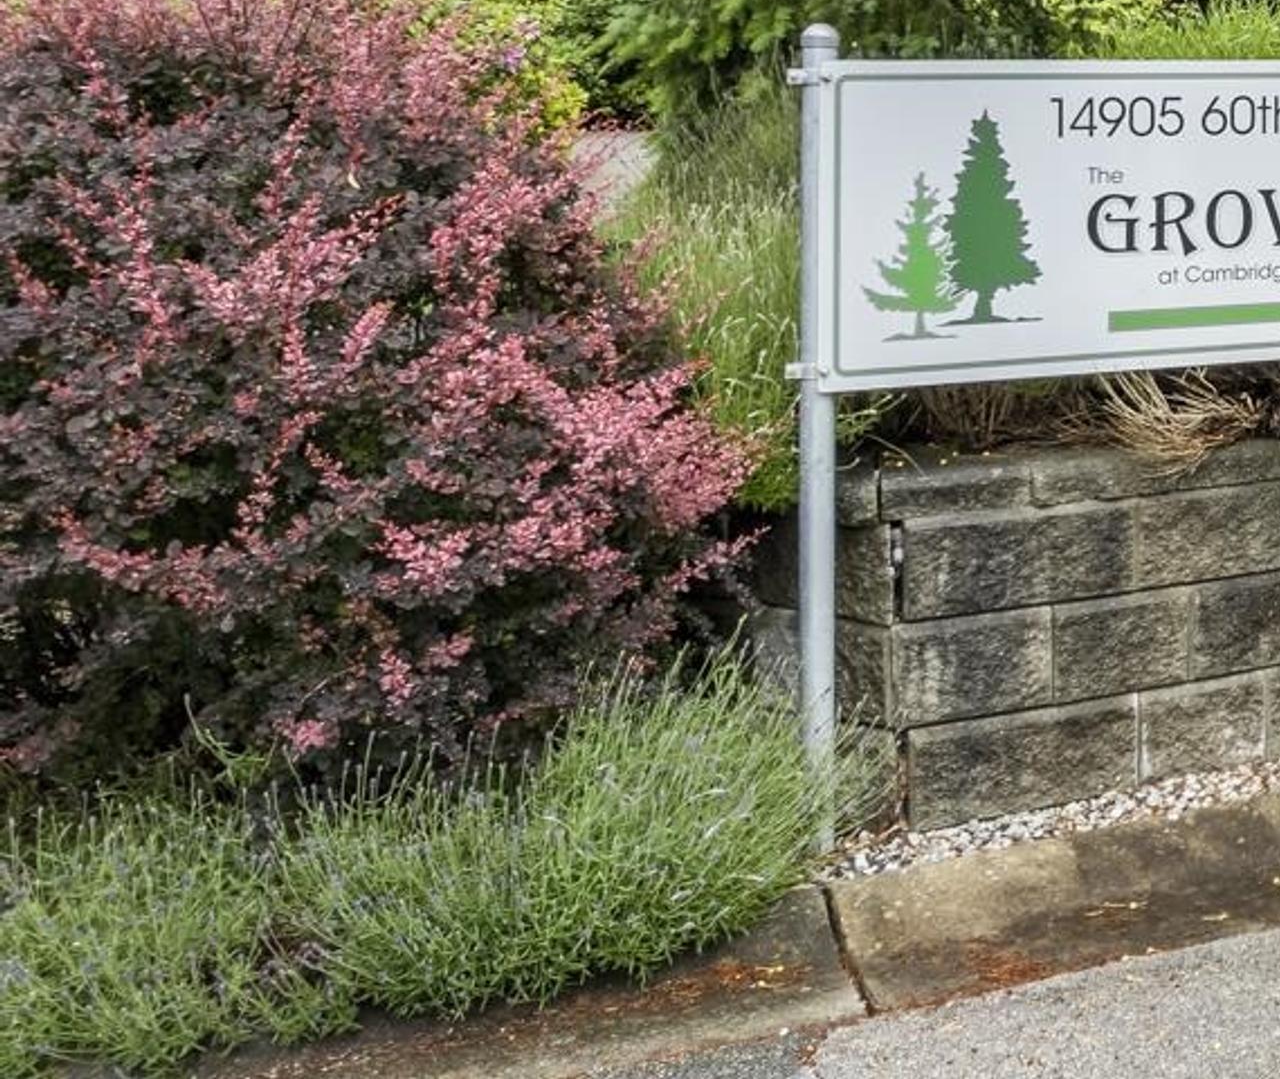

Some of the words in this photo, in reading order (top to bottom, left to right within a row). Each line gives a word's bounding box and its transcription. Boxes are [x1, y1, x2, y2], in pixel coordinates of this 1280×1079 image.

[1049, 95, 1185, 138] 14905
[1087, 165, 1125, 185] The
[1157, 264, 1181, 286] at
